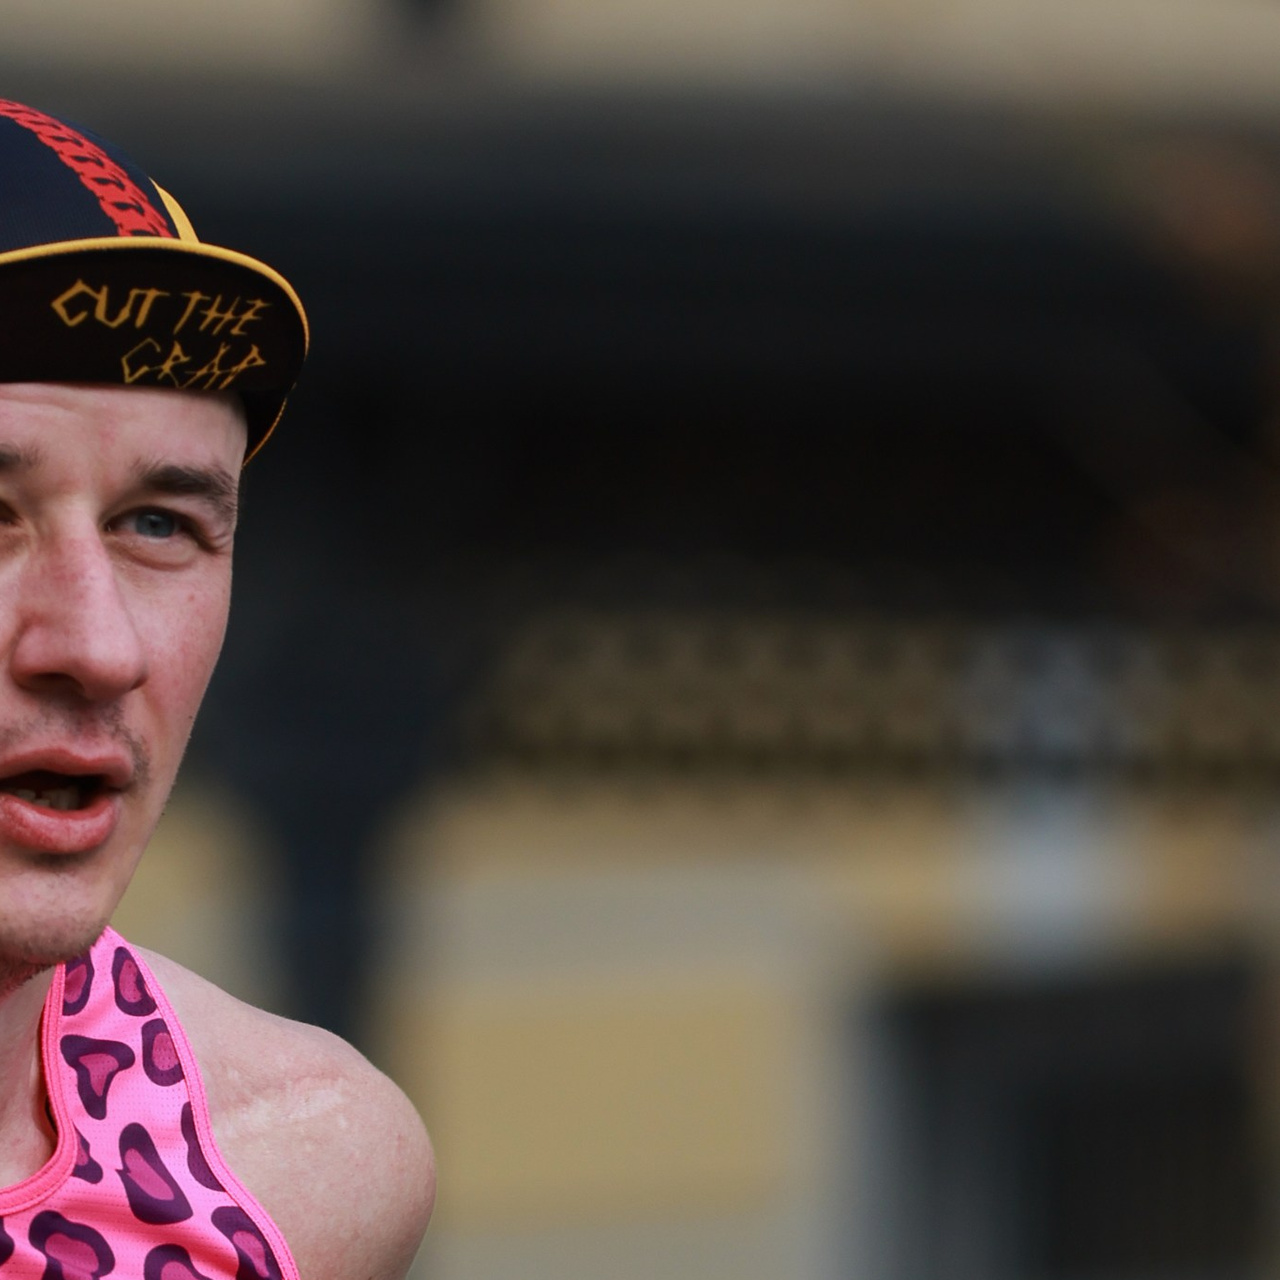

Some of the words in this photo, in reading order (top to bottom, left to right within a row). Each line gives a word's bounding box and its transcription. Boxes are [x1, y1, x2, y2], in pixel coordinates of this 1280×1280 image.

[51, 278, 170, 328] CUT
[181, 291, 272, 336] THE
[121, 337, 267, 390] CRAP
